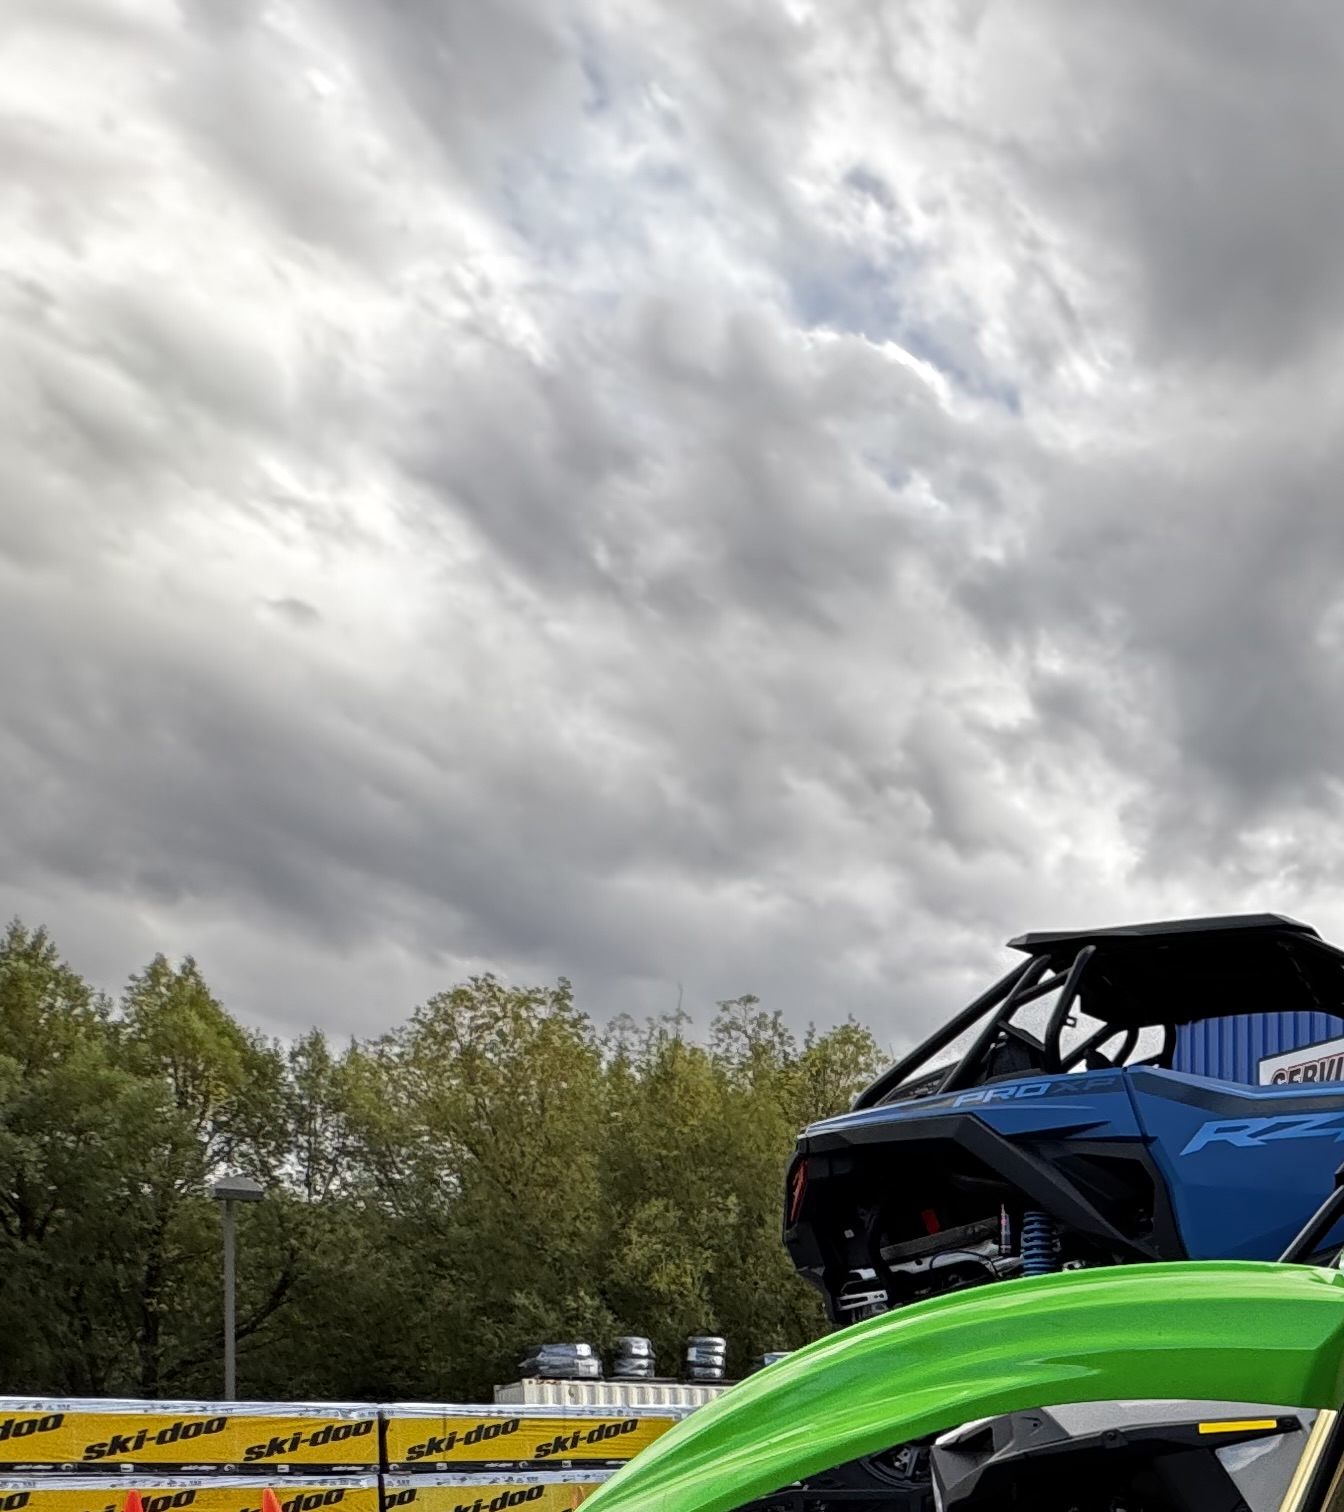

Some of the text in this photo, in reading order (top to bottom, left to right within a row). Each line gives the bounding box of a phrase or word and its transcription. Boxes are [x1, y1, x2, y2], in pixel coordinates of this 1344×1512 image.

[953, 1082, 1051, 1107] PRO
[83, 1416, 228, 1461] ski-doo
[243, 1420, 374, 1462] ski-doo
[406, 1418, 520, 1461] ski-doo
[534, 1418, 639, 1459] ski-doo
